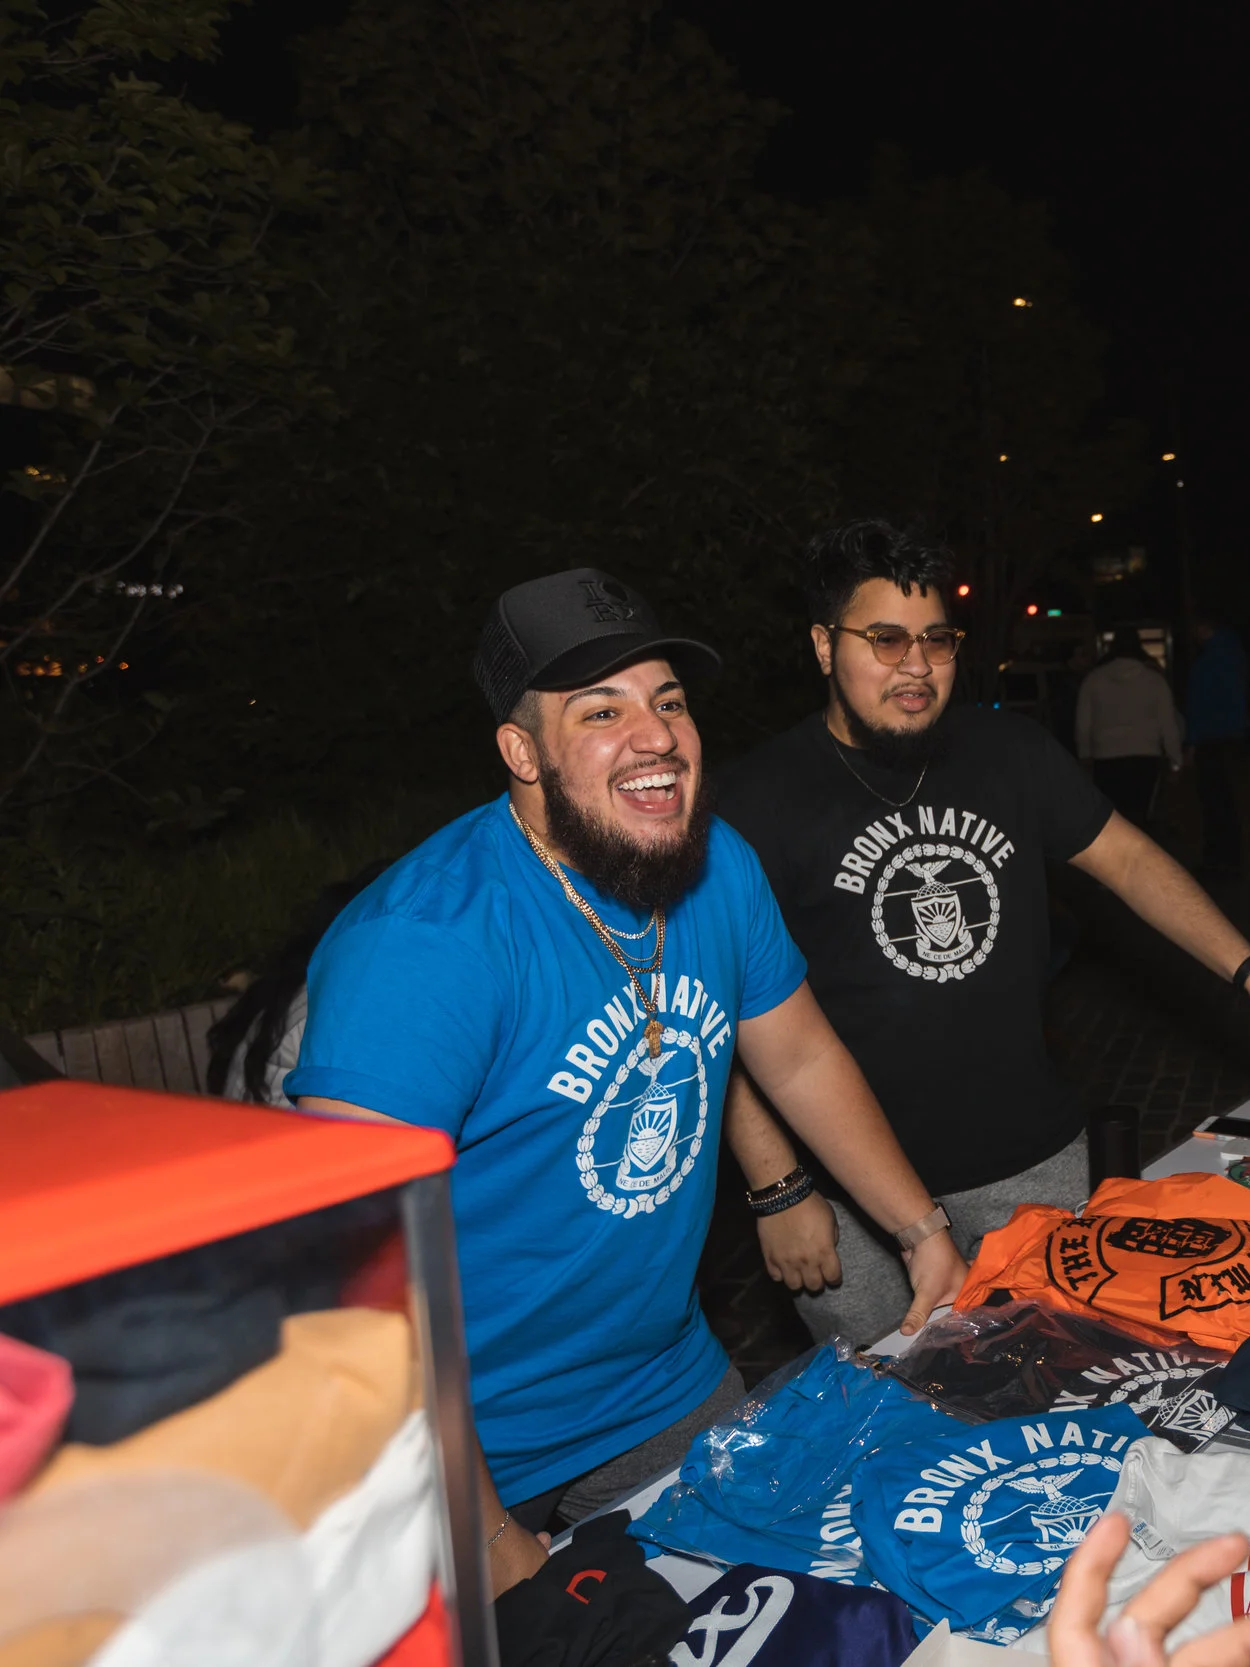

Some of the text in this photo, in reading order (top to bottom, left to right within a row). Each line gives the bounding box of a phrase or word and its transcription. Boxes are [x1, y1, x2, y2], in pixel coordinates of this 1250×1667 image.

[834, 805, 1015, 895] BRONX NATIVE
[547, 981, 648, 1104] BRONX
[1060, 1235, 1098, 1291] THE
[893, 1421, 1129, 1533] BRONX NATI
